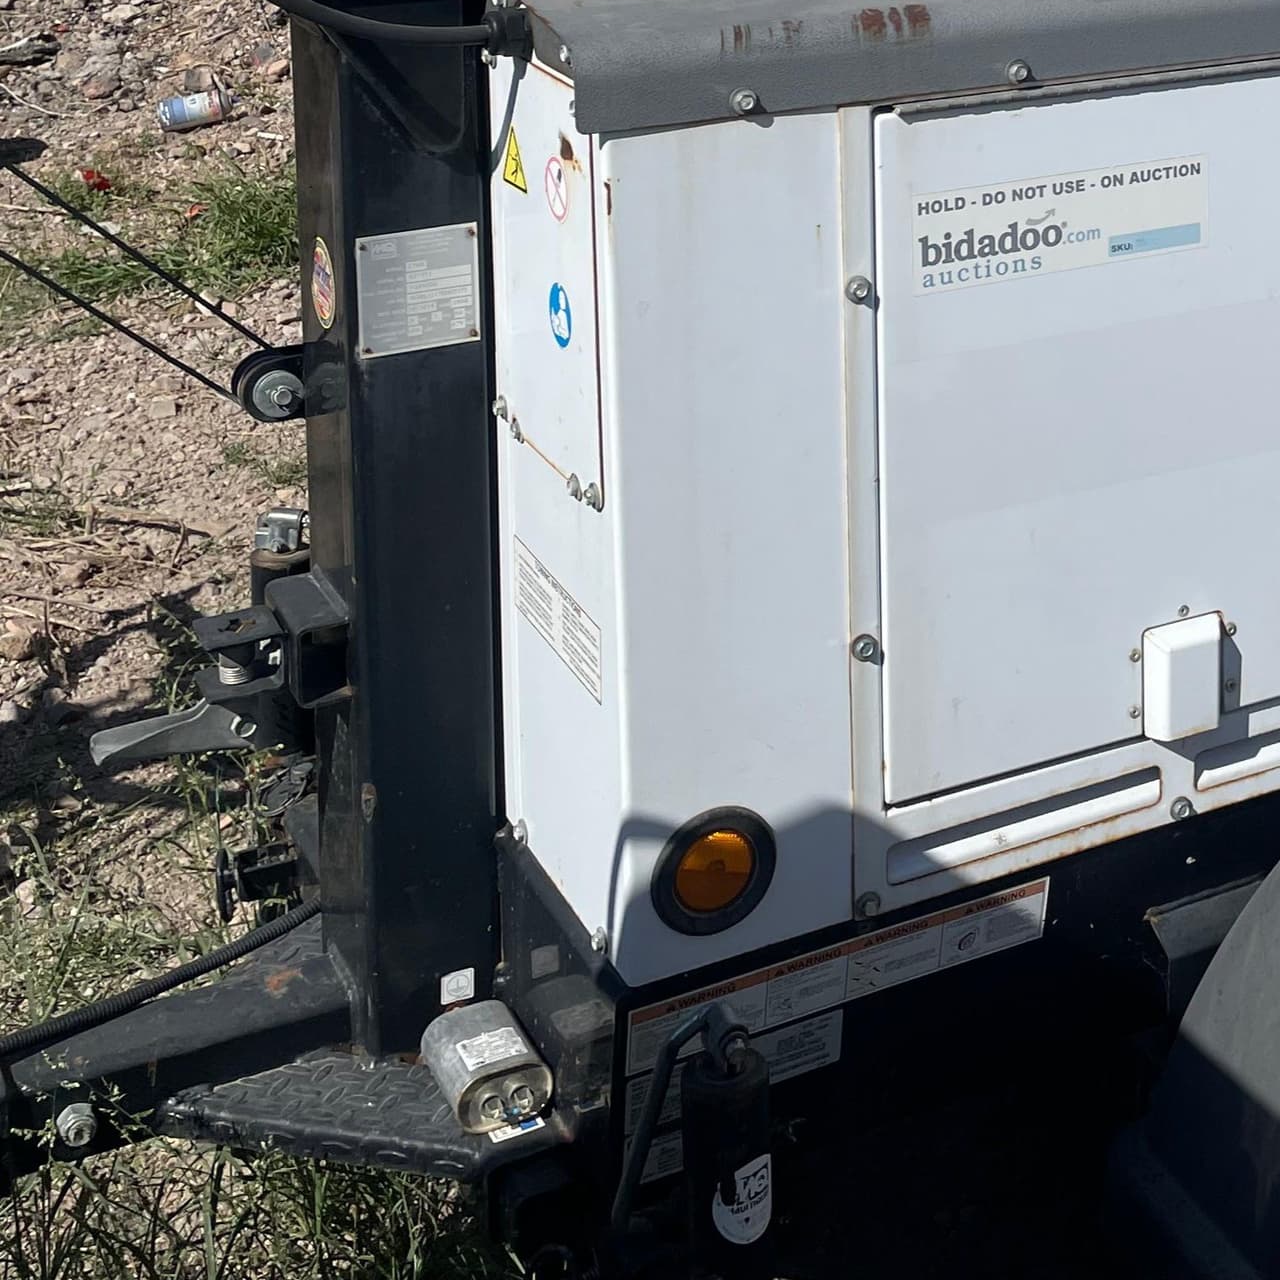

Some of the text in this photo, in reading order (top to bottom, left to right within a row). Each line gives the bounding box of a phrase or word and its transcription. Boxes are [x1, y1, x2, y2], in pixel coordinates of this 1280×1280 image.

[917, 196, 966, 217] HOLD
[981, 190, 1006, 207] DO
[1011, 184, 1047, 202] NOT
[1052, 178, 1086, 197] USE
[1100, 173, 1125, 189] ON
[1128, 161, 1201, 185] AUCTION
[1110, 242, 1134, 254] SKU:
[922, 254, 1043, 288] auctions
[976, 888, 1027, 912] WARNING
[875, 918, 929, 945] WARNING
[786, 947, 843, 974] WARNING
[679, 982, 738, 1010] WARNING
